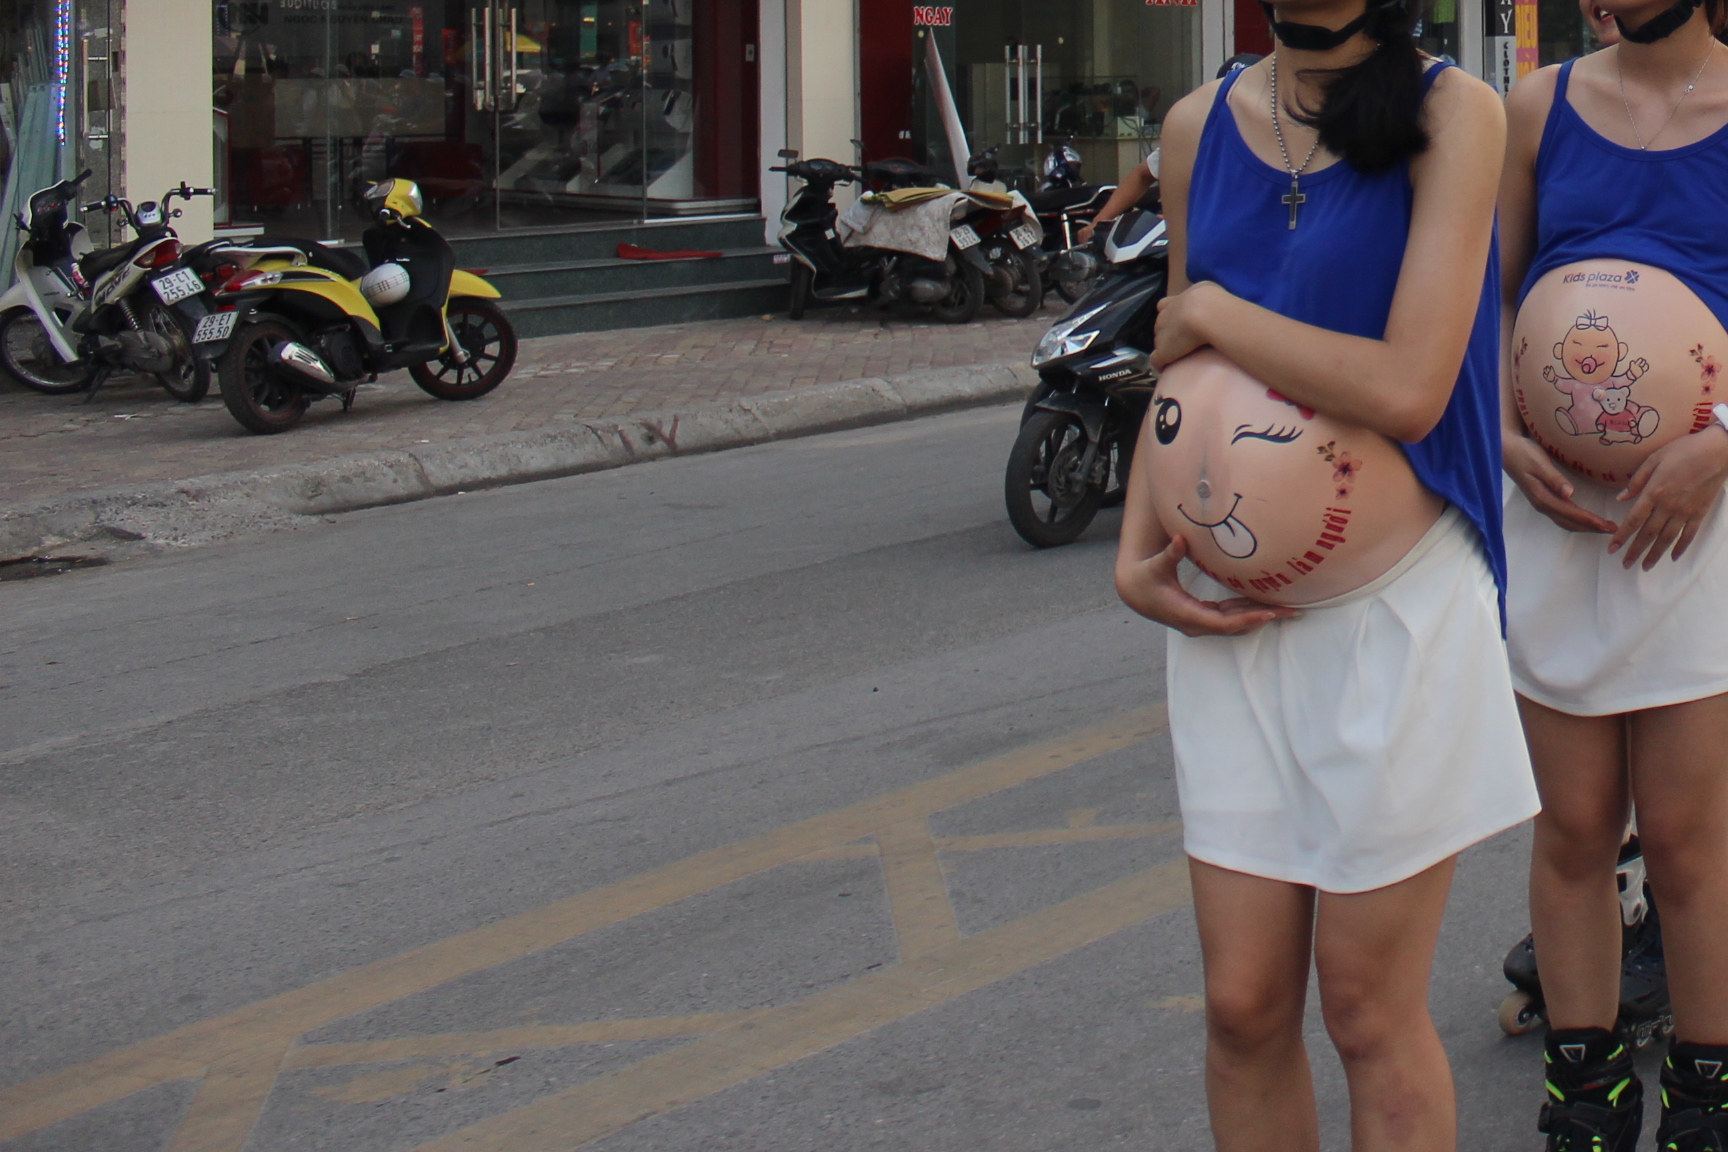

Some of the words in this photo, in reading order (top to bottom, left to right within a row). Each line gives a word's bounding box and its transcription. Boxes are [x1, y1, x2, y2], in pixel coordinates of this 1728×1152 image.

[913, 6, 953, 26] NGAY
[159, 270, 192, 289] 29-C1
[1563, 272, 1585, 284] Kids
[1587, 271, 1623, 284] plaza
[163, 279, 202, 304] 255.46
[203, 313, 231, 328] 29-E1
[195, 326, 230, 342] 555.50
[1098, 369, 1132, 382] HONDA
